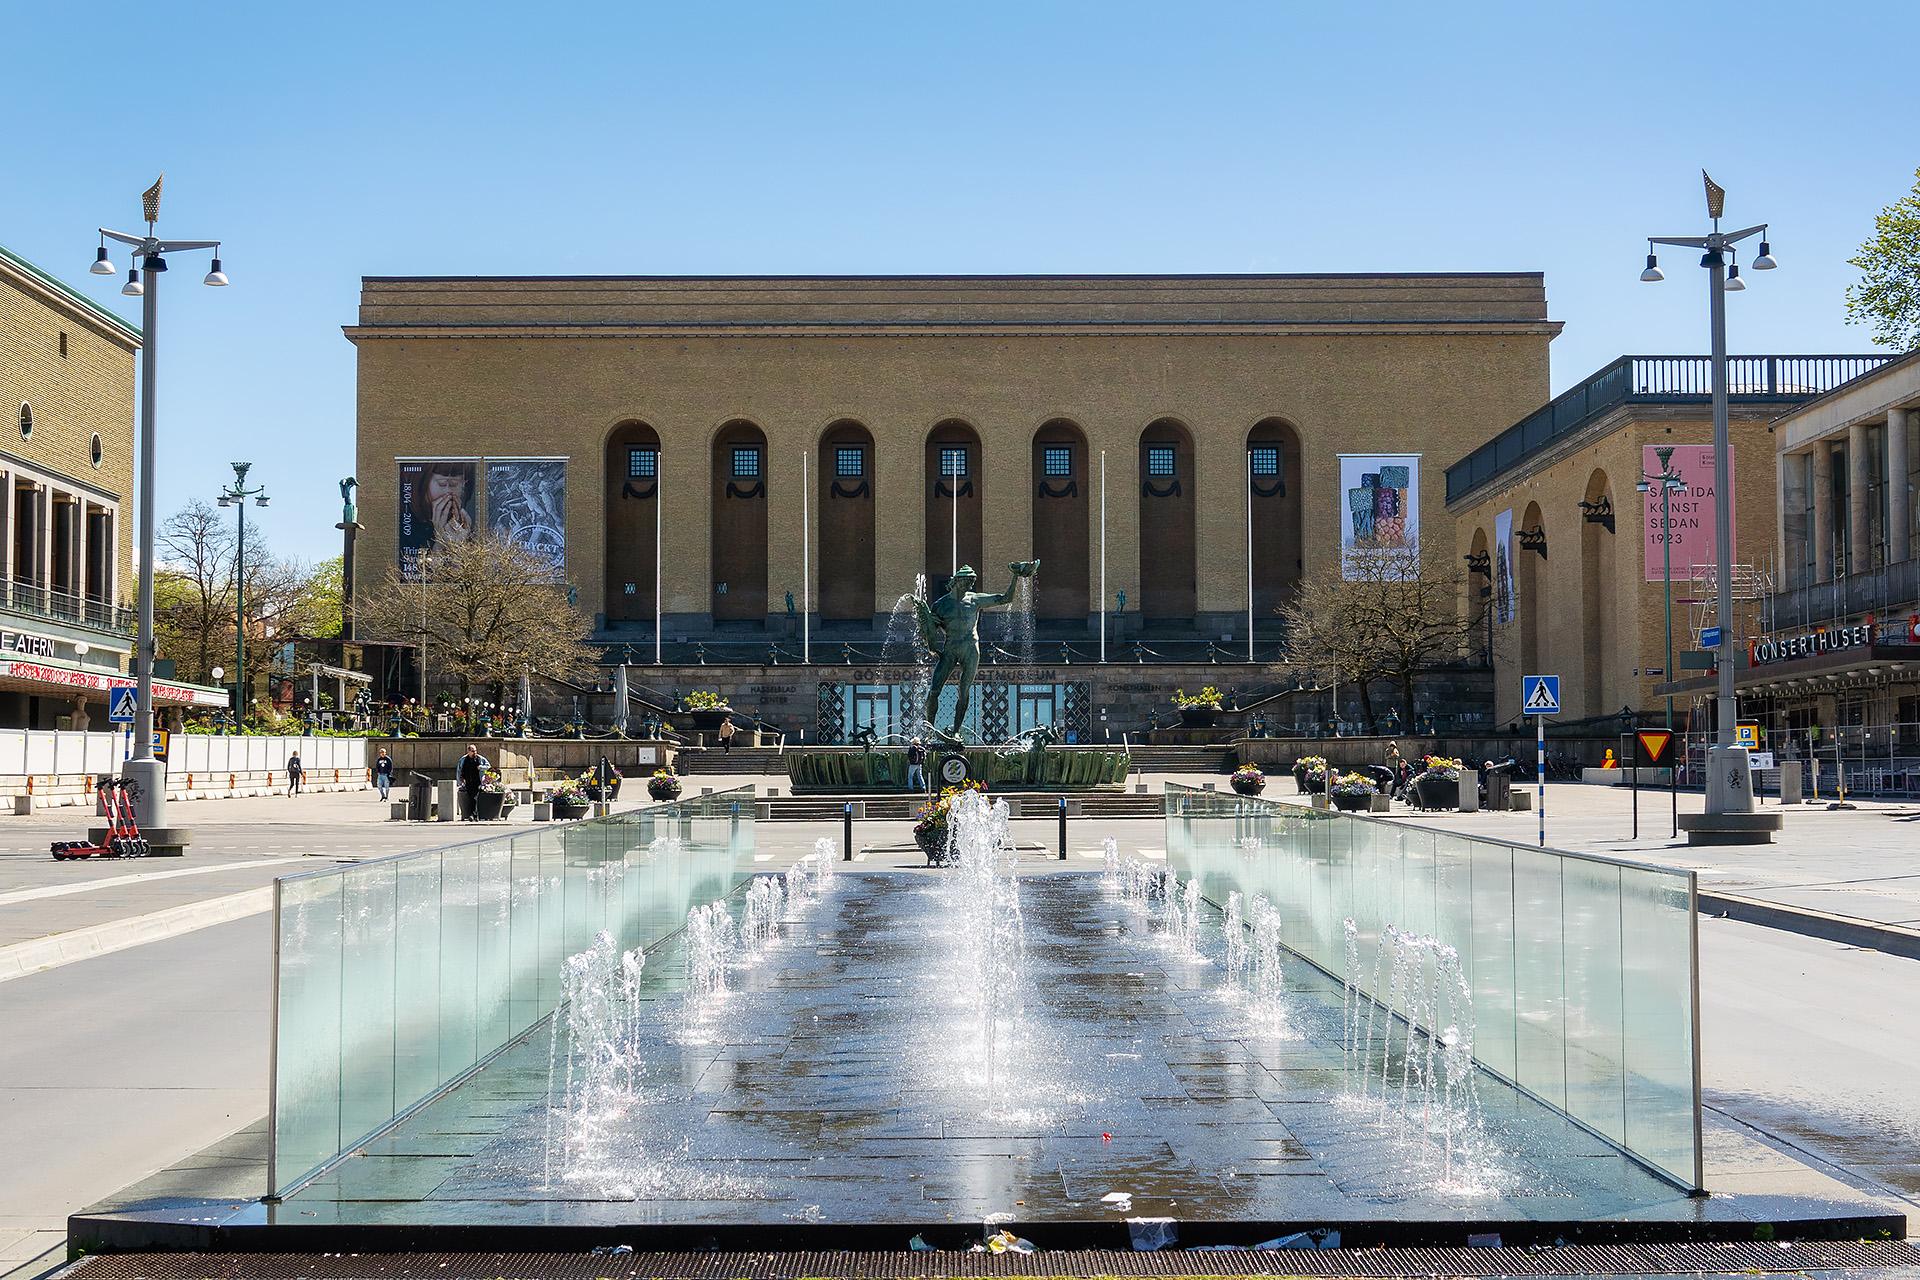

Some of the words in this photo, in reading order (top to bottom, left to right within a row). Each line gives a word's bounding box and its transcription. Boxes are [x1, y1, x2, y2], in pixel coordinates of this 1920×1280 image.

[1650, 502, 1699, 513] KONST
[1650, 518, 1699, 529] SEDAN
[1650, 533, 1683, 544] 1923
[1754, 625, 1871, 661] KONSERTHUSET
